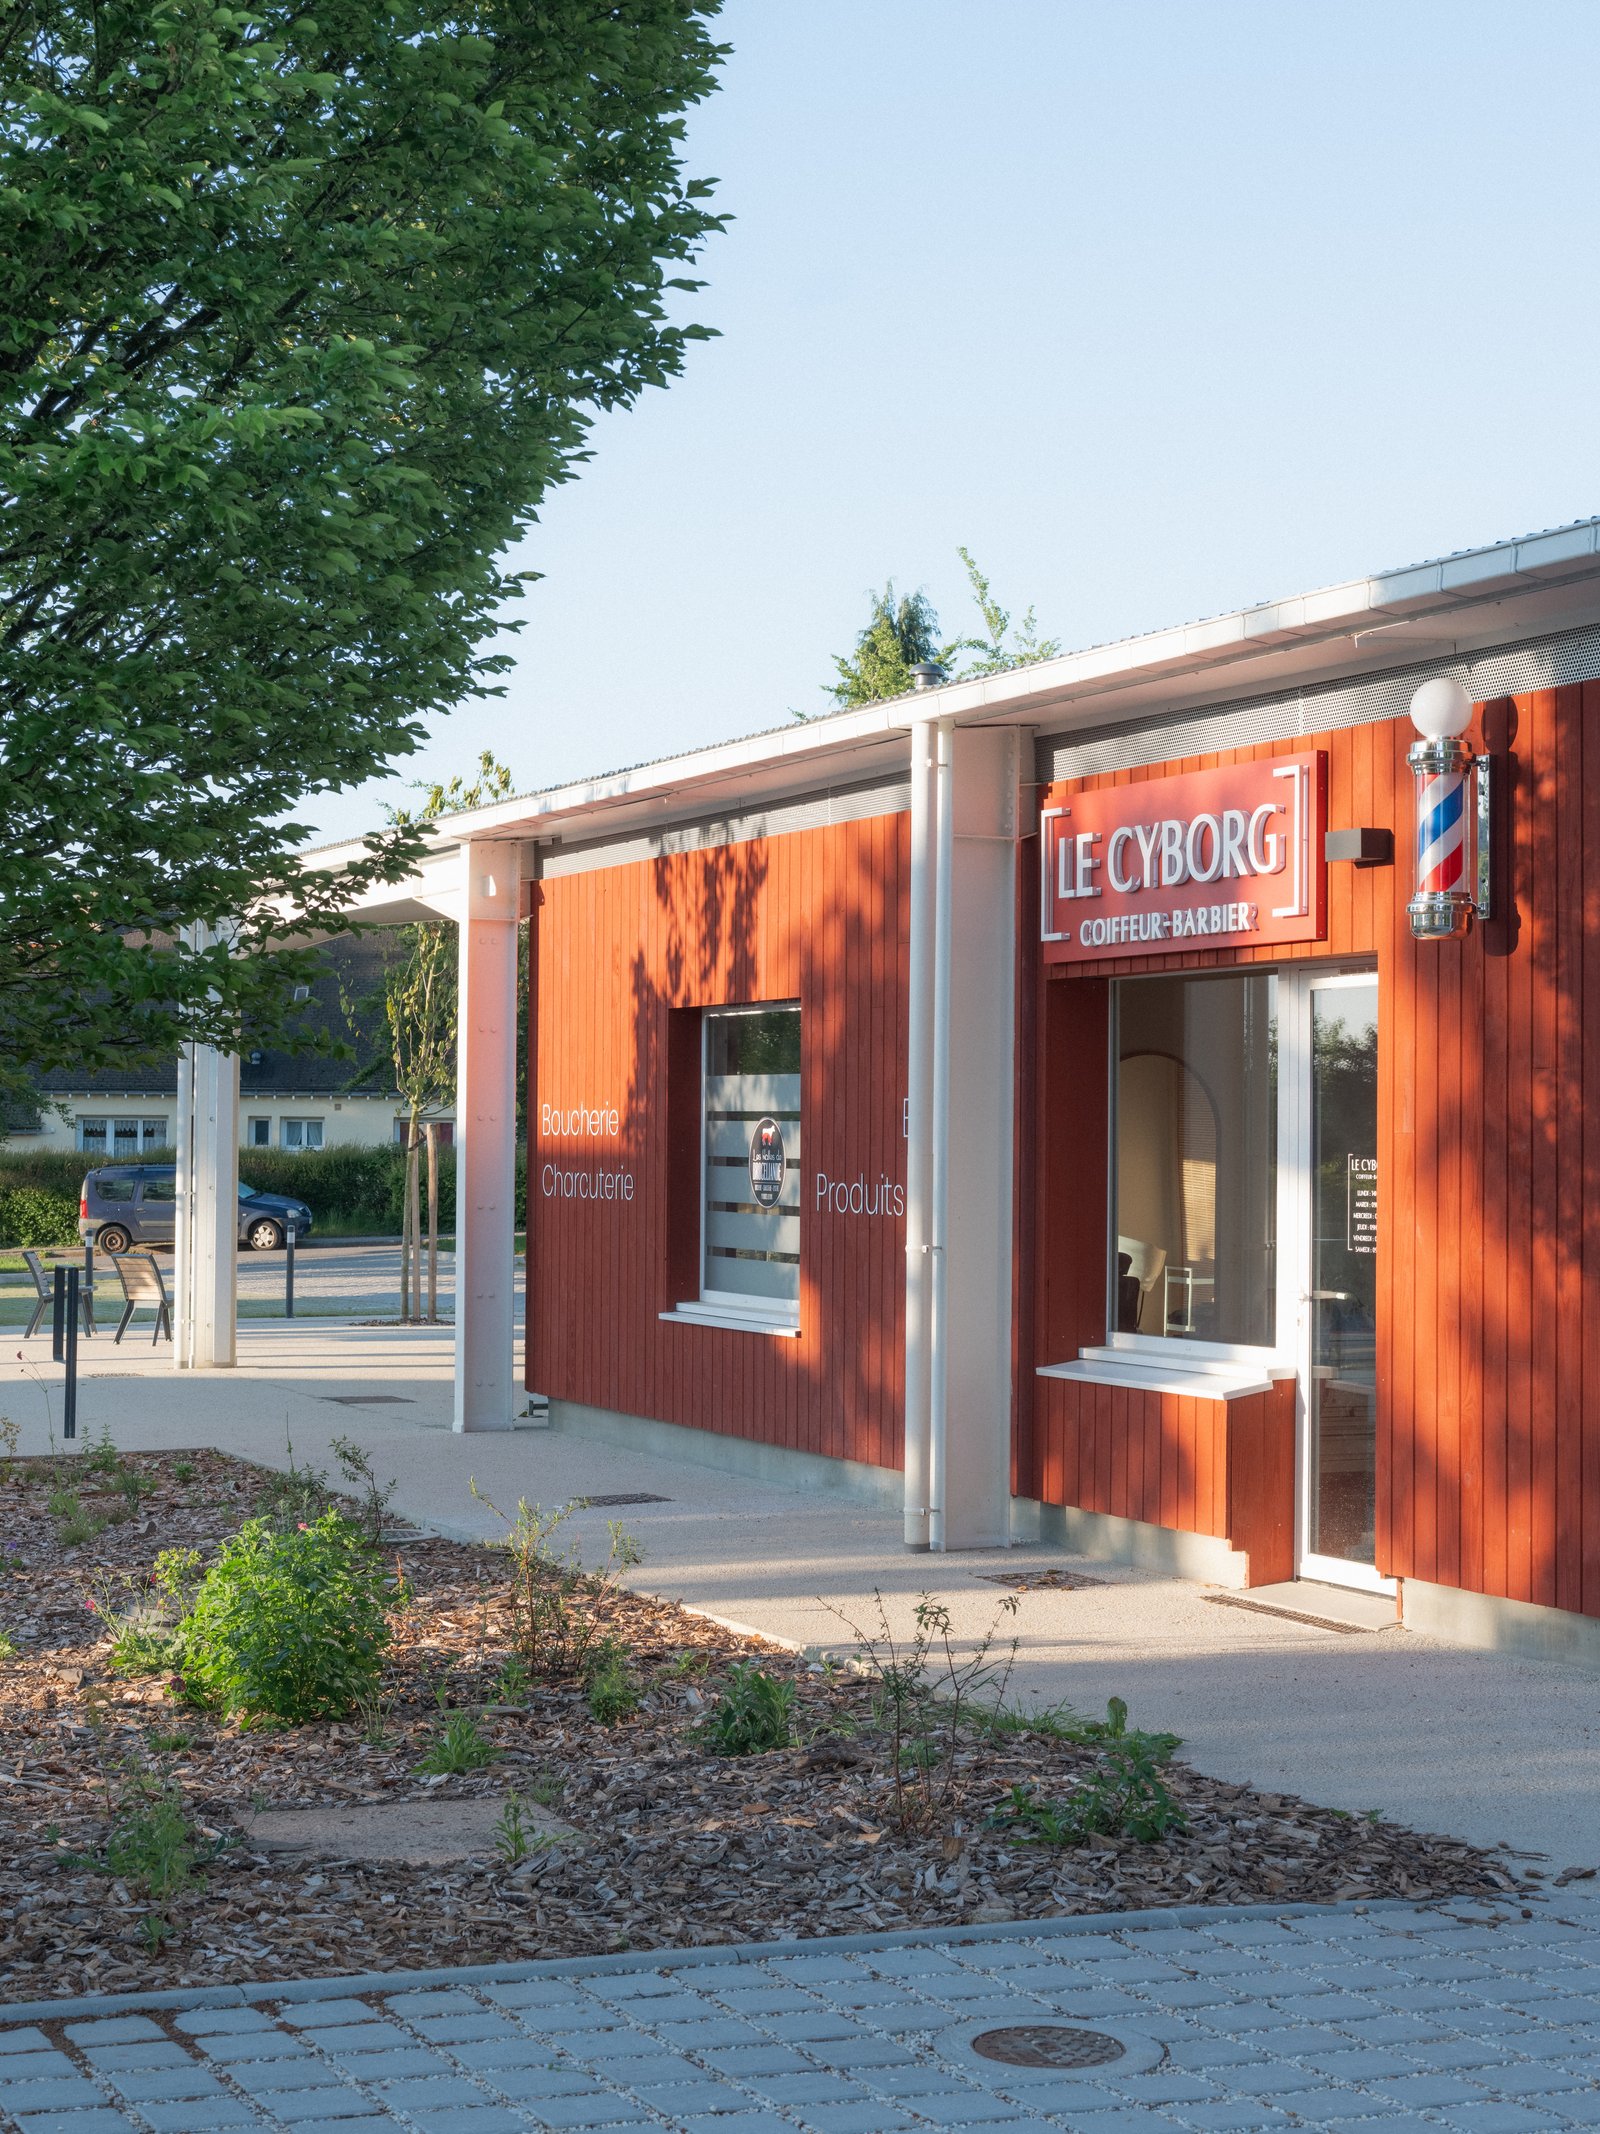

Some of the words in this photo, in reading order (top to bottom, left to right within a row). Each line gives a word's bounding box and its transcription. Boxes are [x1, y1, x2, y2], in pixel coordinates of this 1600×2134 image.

[1058, 832, 1100, 899] LE
[1108, 803, 1284, 893] CYBORG
[1079, 902, 1257, 948] COIFFEUR-BARBIER
[542, 1101, 619, 1136] Boucherie
[542, 1163, 634, 1201] Charcuterie
[1351, 1159, 1360, 1171] LE
[1361, 1159, 1377, 1171] CYB
[816, 1173, 905, 1217] Produits
